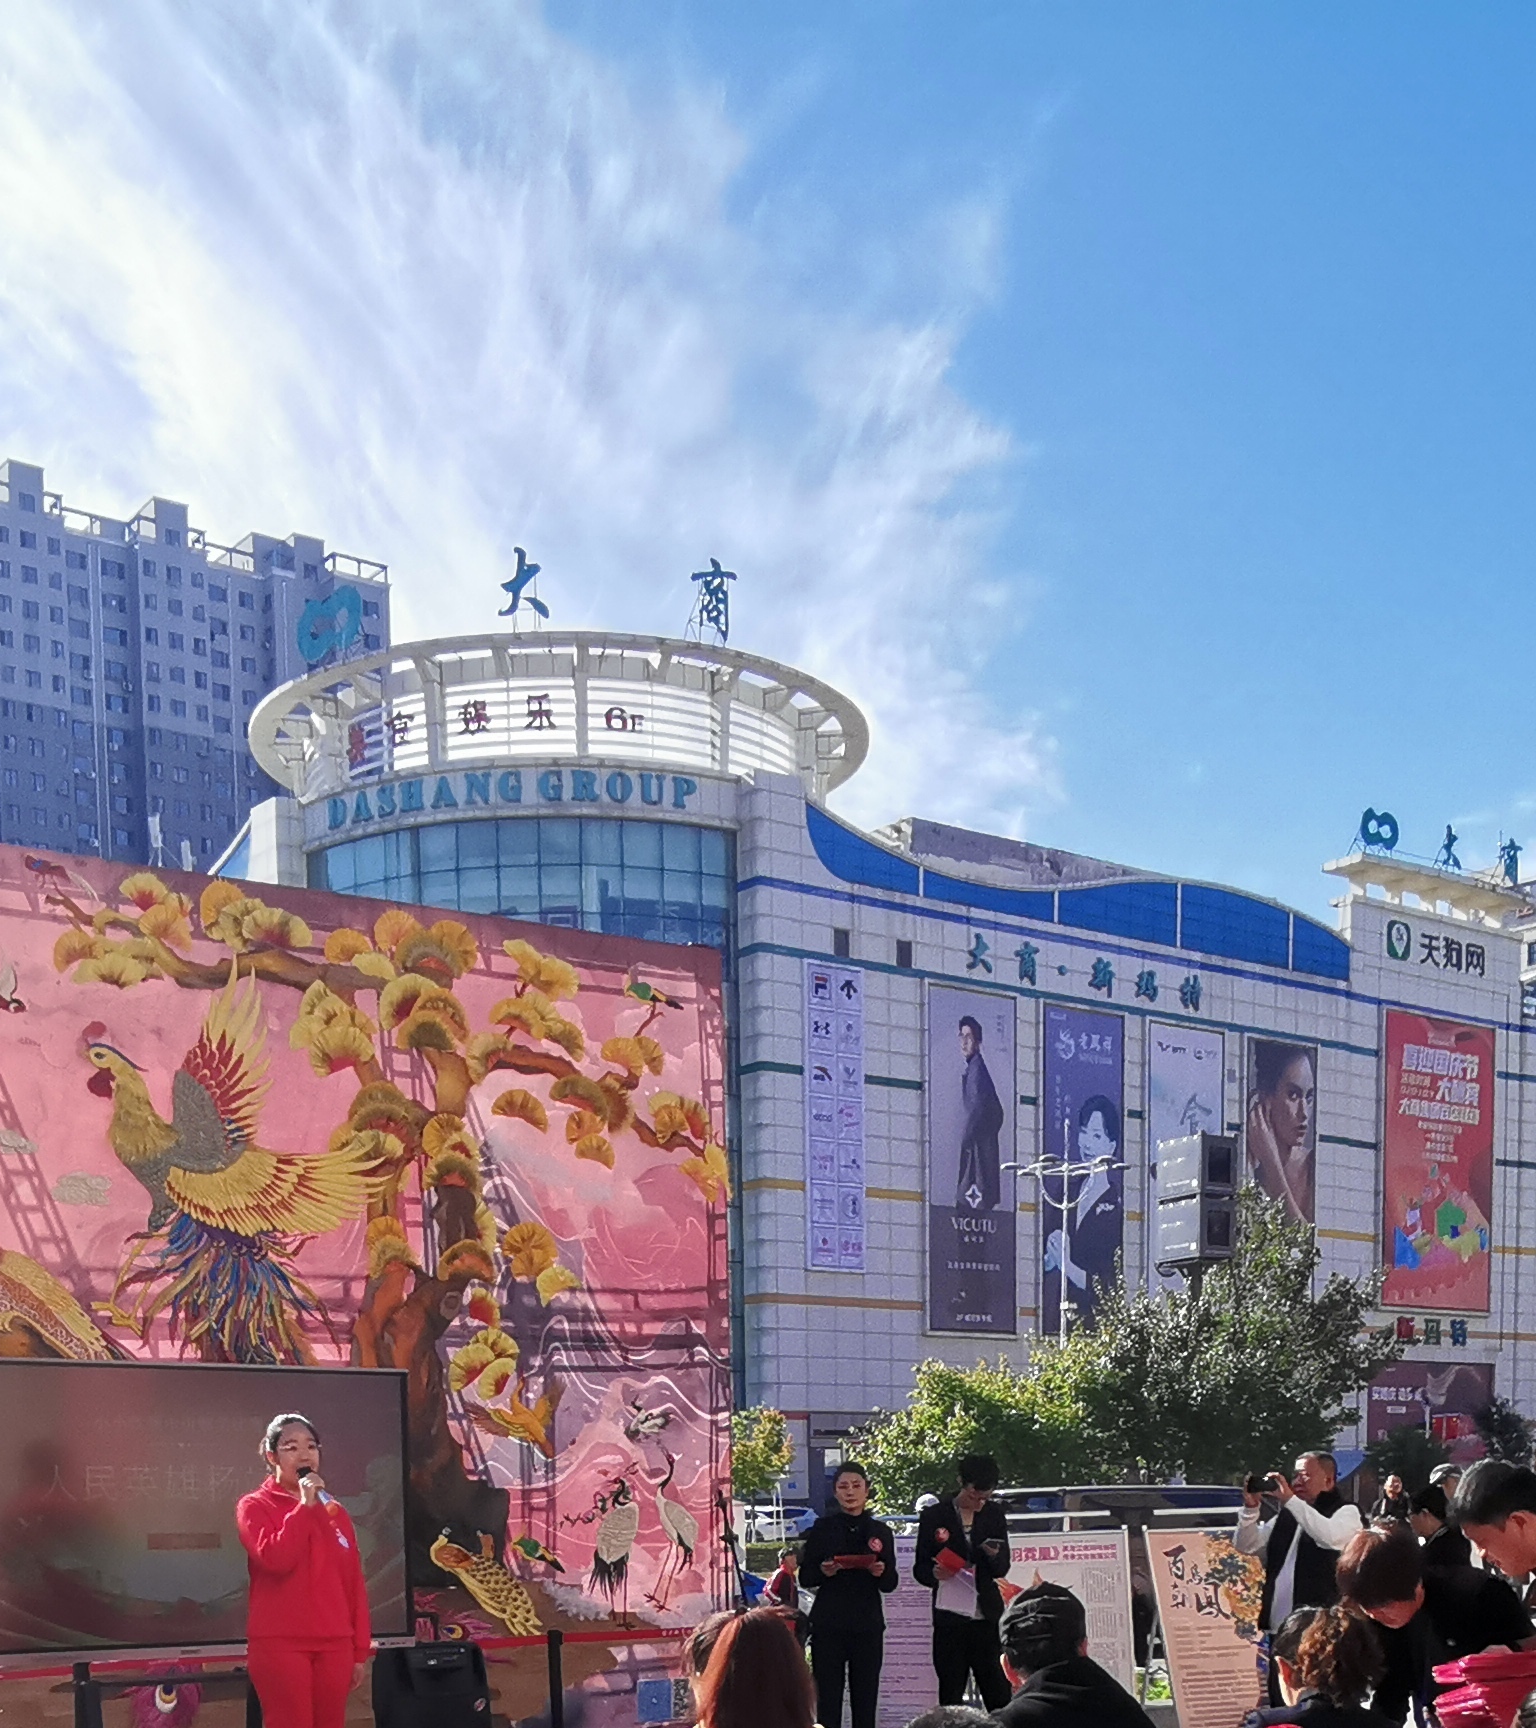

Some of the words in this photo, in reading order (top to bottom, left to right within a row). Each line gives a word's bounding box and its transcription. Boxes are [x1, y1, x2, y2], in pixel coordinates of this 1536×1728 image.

[498, 546, 738, 643] 大商
[326, 769, 523, 830] DASHANG
[536, 769, 698, 809] GROUP
[1419, 932, 1487, 978] 天狗网
[950, 1215, 998, 1234] VICUTU
